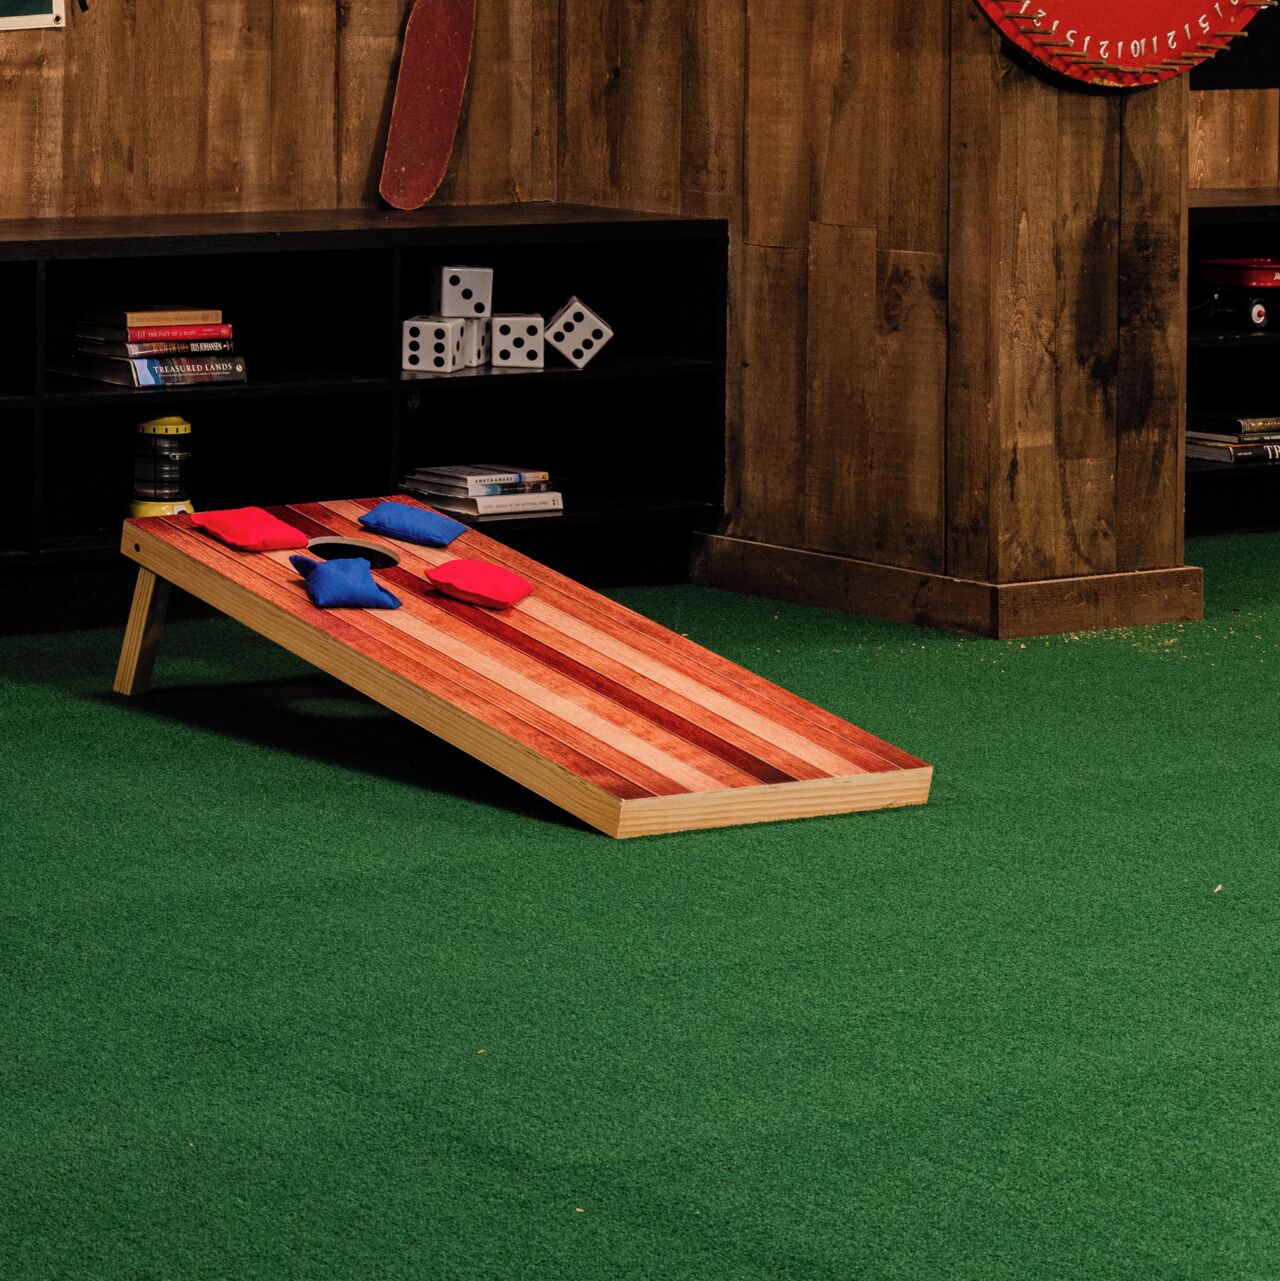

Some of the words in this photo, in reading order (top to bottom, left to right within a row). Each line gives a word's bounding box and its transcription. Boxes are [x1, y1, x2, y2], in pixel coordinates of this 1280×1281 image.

[1214, 2, 1223, 19] 1
[1184, 23, 1191, 41] 1
[1199, 14, 1210, 35] 5
[1083, 36, 1090, 52] 1
[1131, 38, 1146, 58] 10
[1152, 36, 1158, 53] 1
[1167, 31, 1177, 50] 2
[1099, 40, 1109, 59] 2
[1117, 41, 1123, 58] 1
[200, 342, 223, 351] JOHANSEN
[153, 365, 203, 374] TREASURED
[205, 363, 233, 371] LANDS
